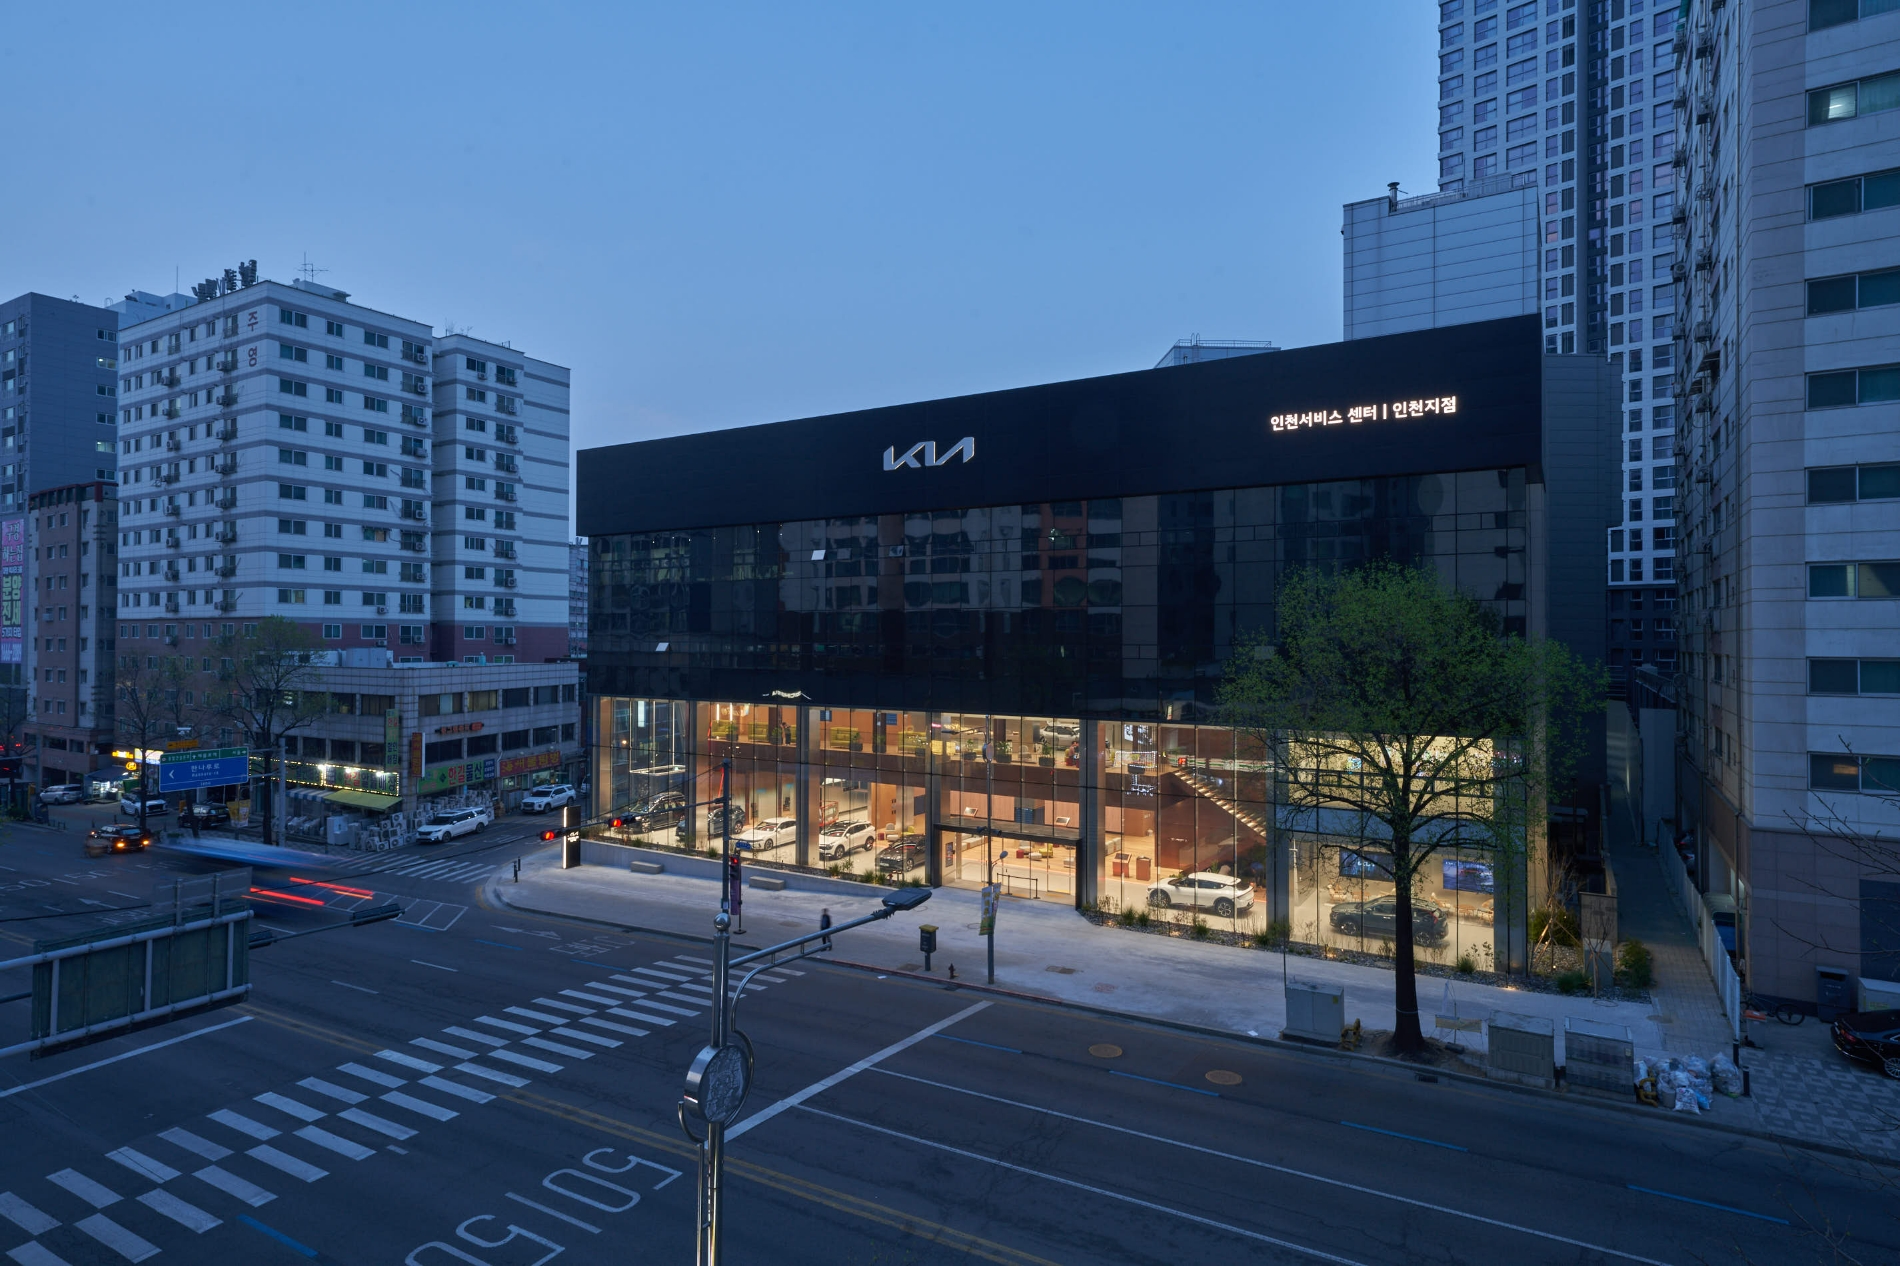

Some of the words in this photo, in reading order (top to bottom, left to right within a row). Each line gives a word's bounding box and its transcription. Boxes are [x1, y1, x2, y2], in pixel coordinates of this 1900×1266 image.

[1270, 409, 1344, 432] 인천서비스
[1347, 404, 1378, 423] 센터
[1392, 395, 1458, 419] 인천지점
[883, 436, 975, 472] KIA
[2, 544, 23, 563] 하는집
[2, 574, 22, 601] 분양
[2, 600, 21, 626] 전세
[448, 761, 483, 786] 한길물산
